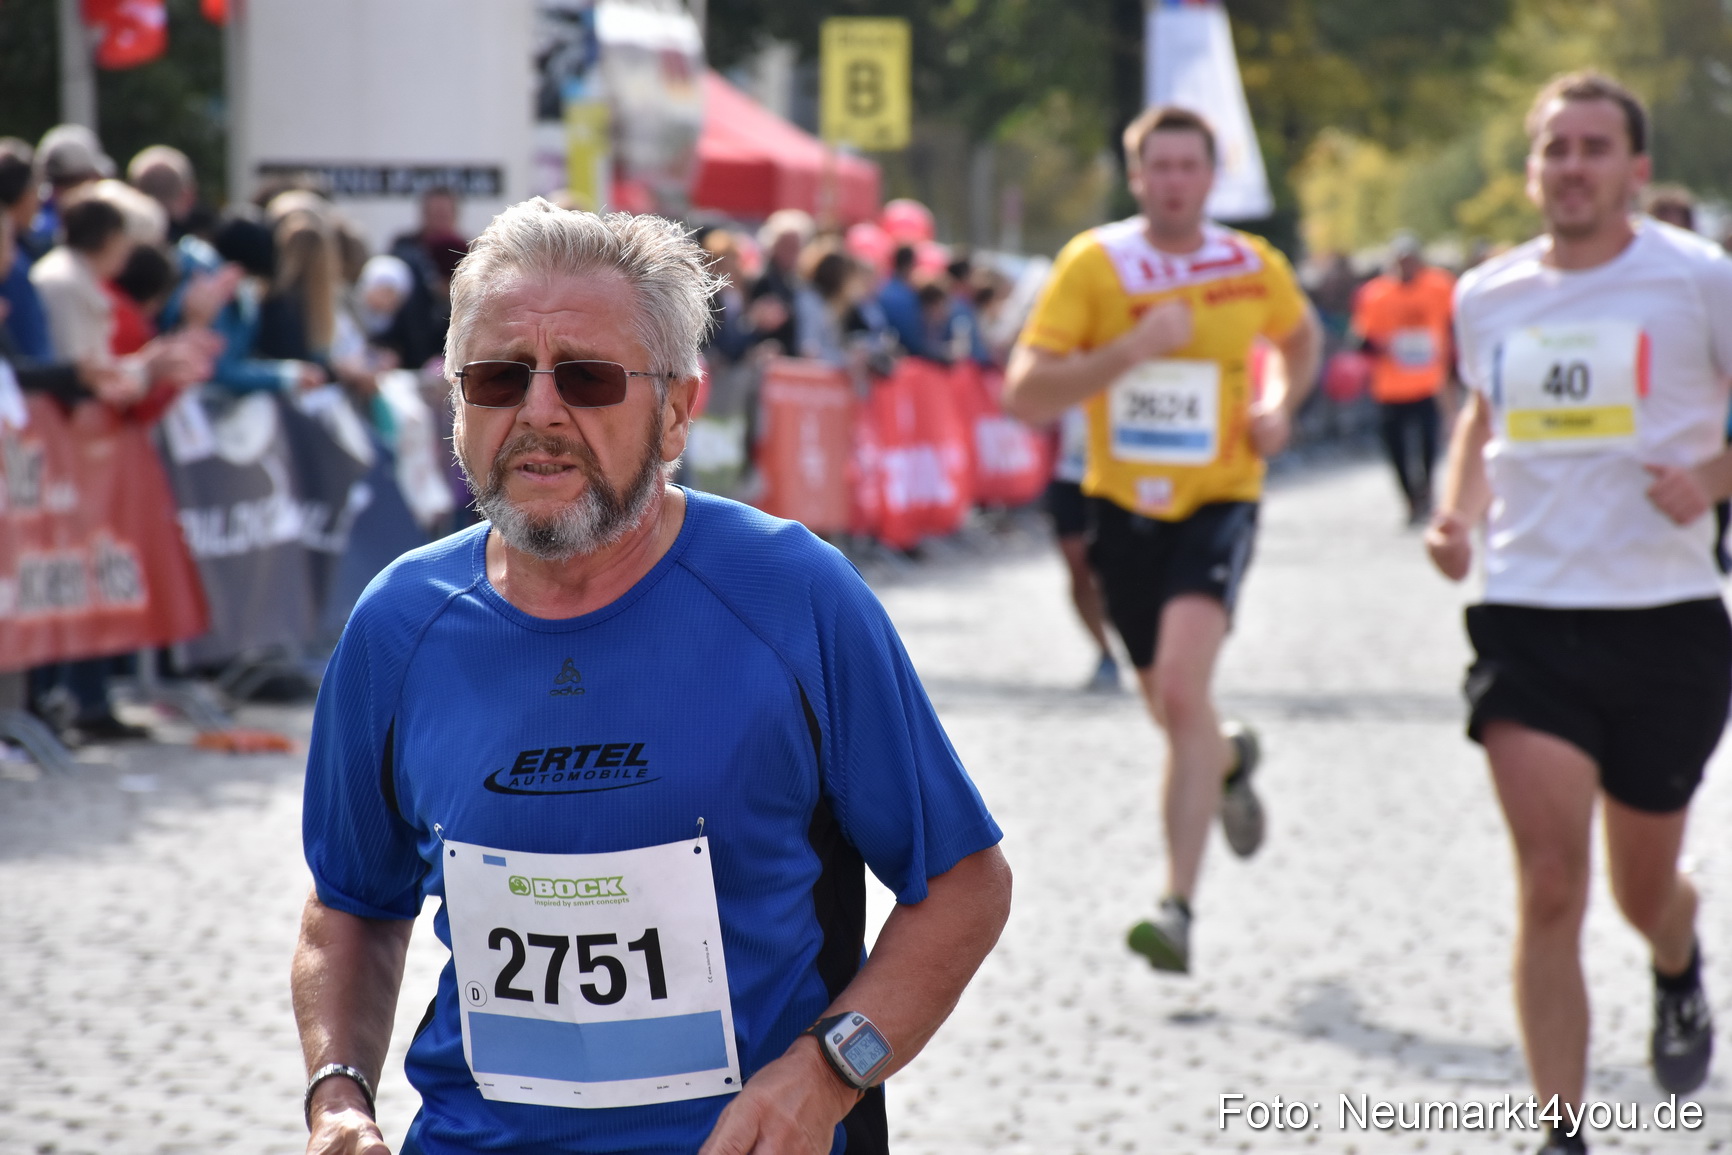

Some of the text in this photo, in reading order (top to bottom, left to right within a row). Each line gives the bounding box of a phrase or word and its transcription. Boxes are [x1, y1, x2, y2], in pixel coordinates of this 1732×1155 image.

[1543, 361, 1590, 400] 40
[510, 743, 649, 776] ERTEL
[508, 768, 649, 787] AUTOMOBILE
[532, 875, 628, 898] BOCK
[534, 898, 560, 907] inspired
[562, 899, 571, 908] by
[596, 897, 630, 906] concepts
[488, 927, 668, 1006] 2751
[471, 987, 480, 1001] D
